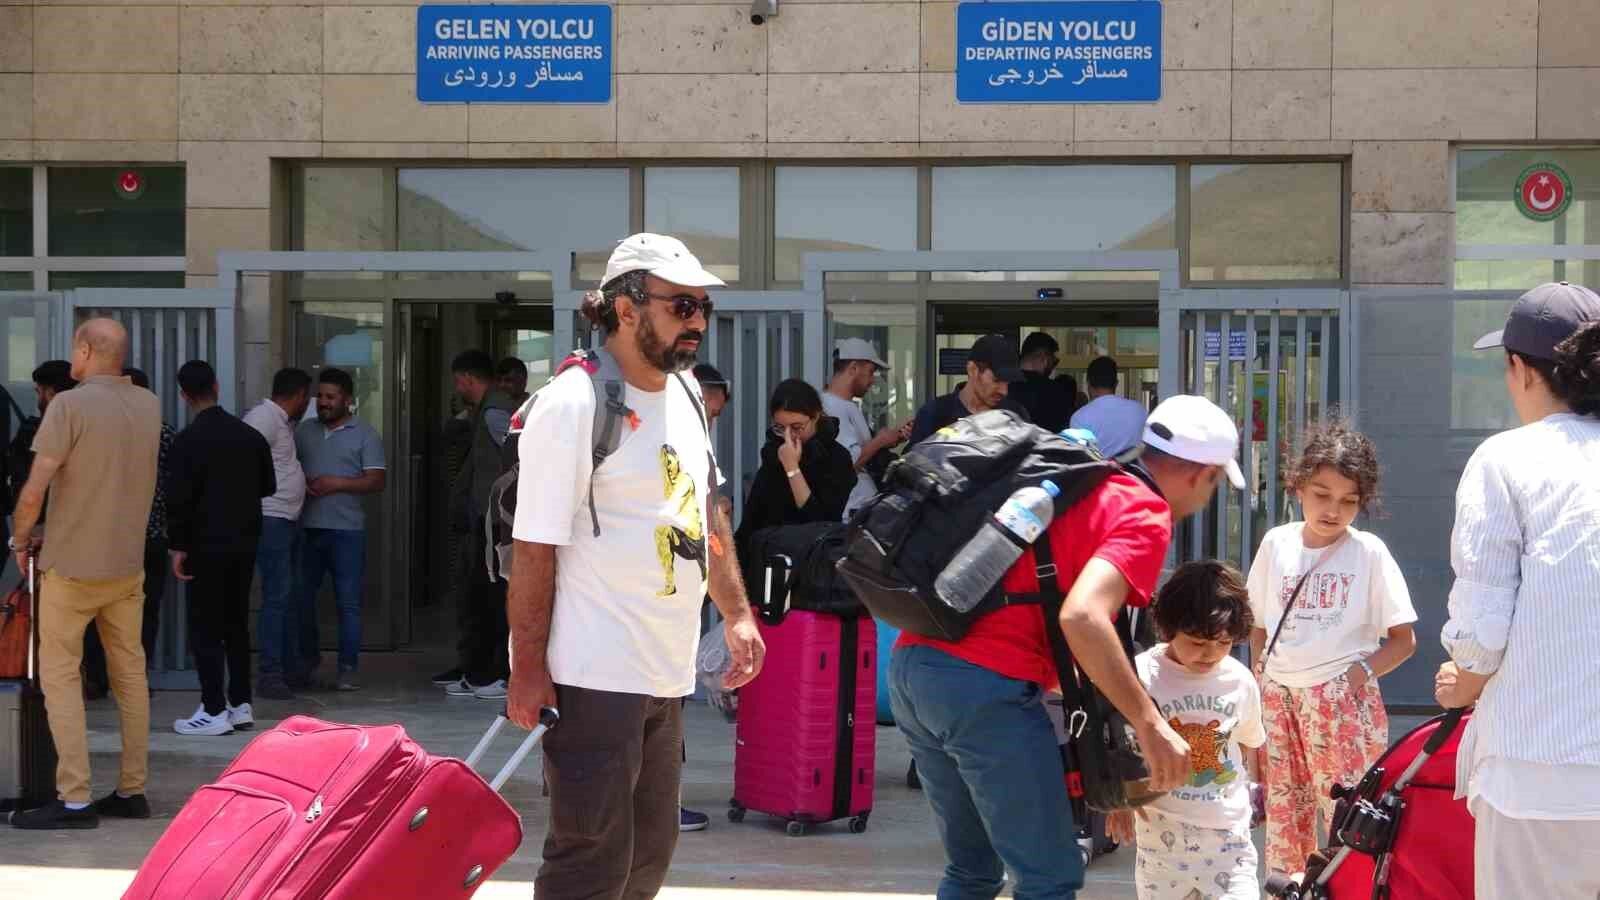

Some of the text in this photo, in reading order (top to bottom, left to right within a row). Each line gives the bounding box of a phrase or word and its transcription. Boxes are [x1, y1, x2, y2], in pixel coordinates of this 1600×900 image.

[435, 19, 594, 39] GELEN YOLCU
[981, 18, 1136, 41] GİDEN YOLCU
[426, 46, 603, 59] ARRIVING PASSENGERS
[965, 47, 1153, 60] DEPARTING PASSENGERS
[444, 61, 584, 88] مسافر ورودی
[988, 60, 1128, 86] مسافر خروجی
[1161, 693, 1236, 718] PARAISO
